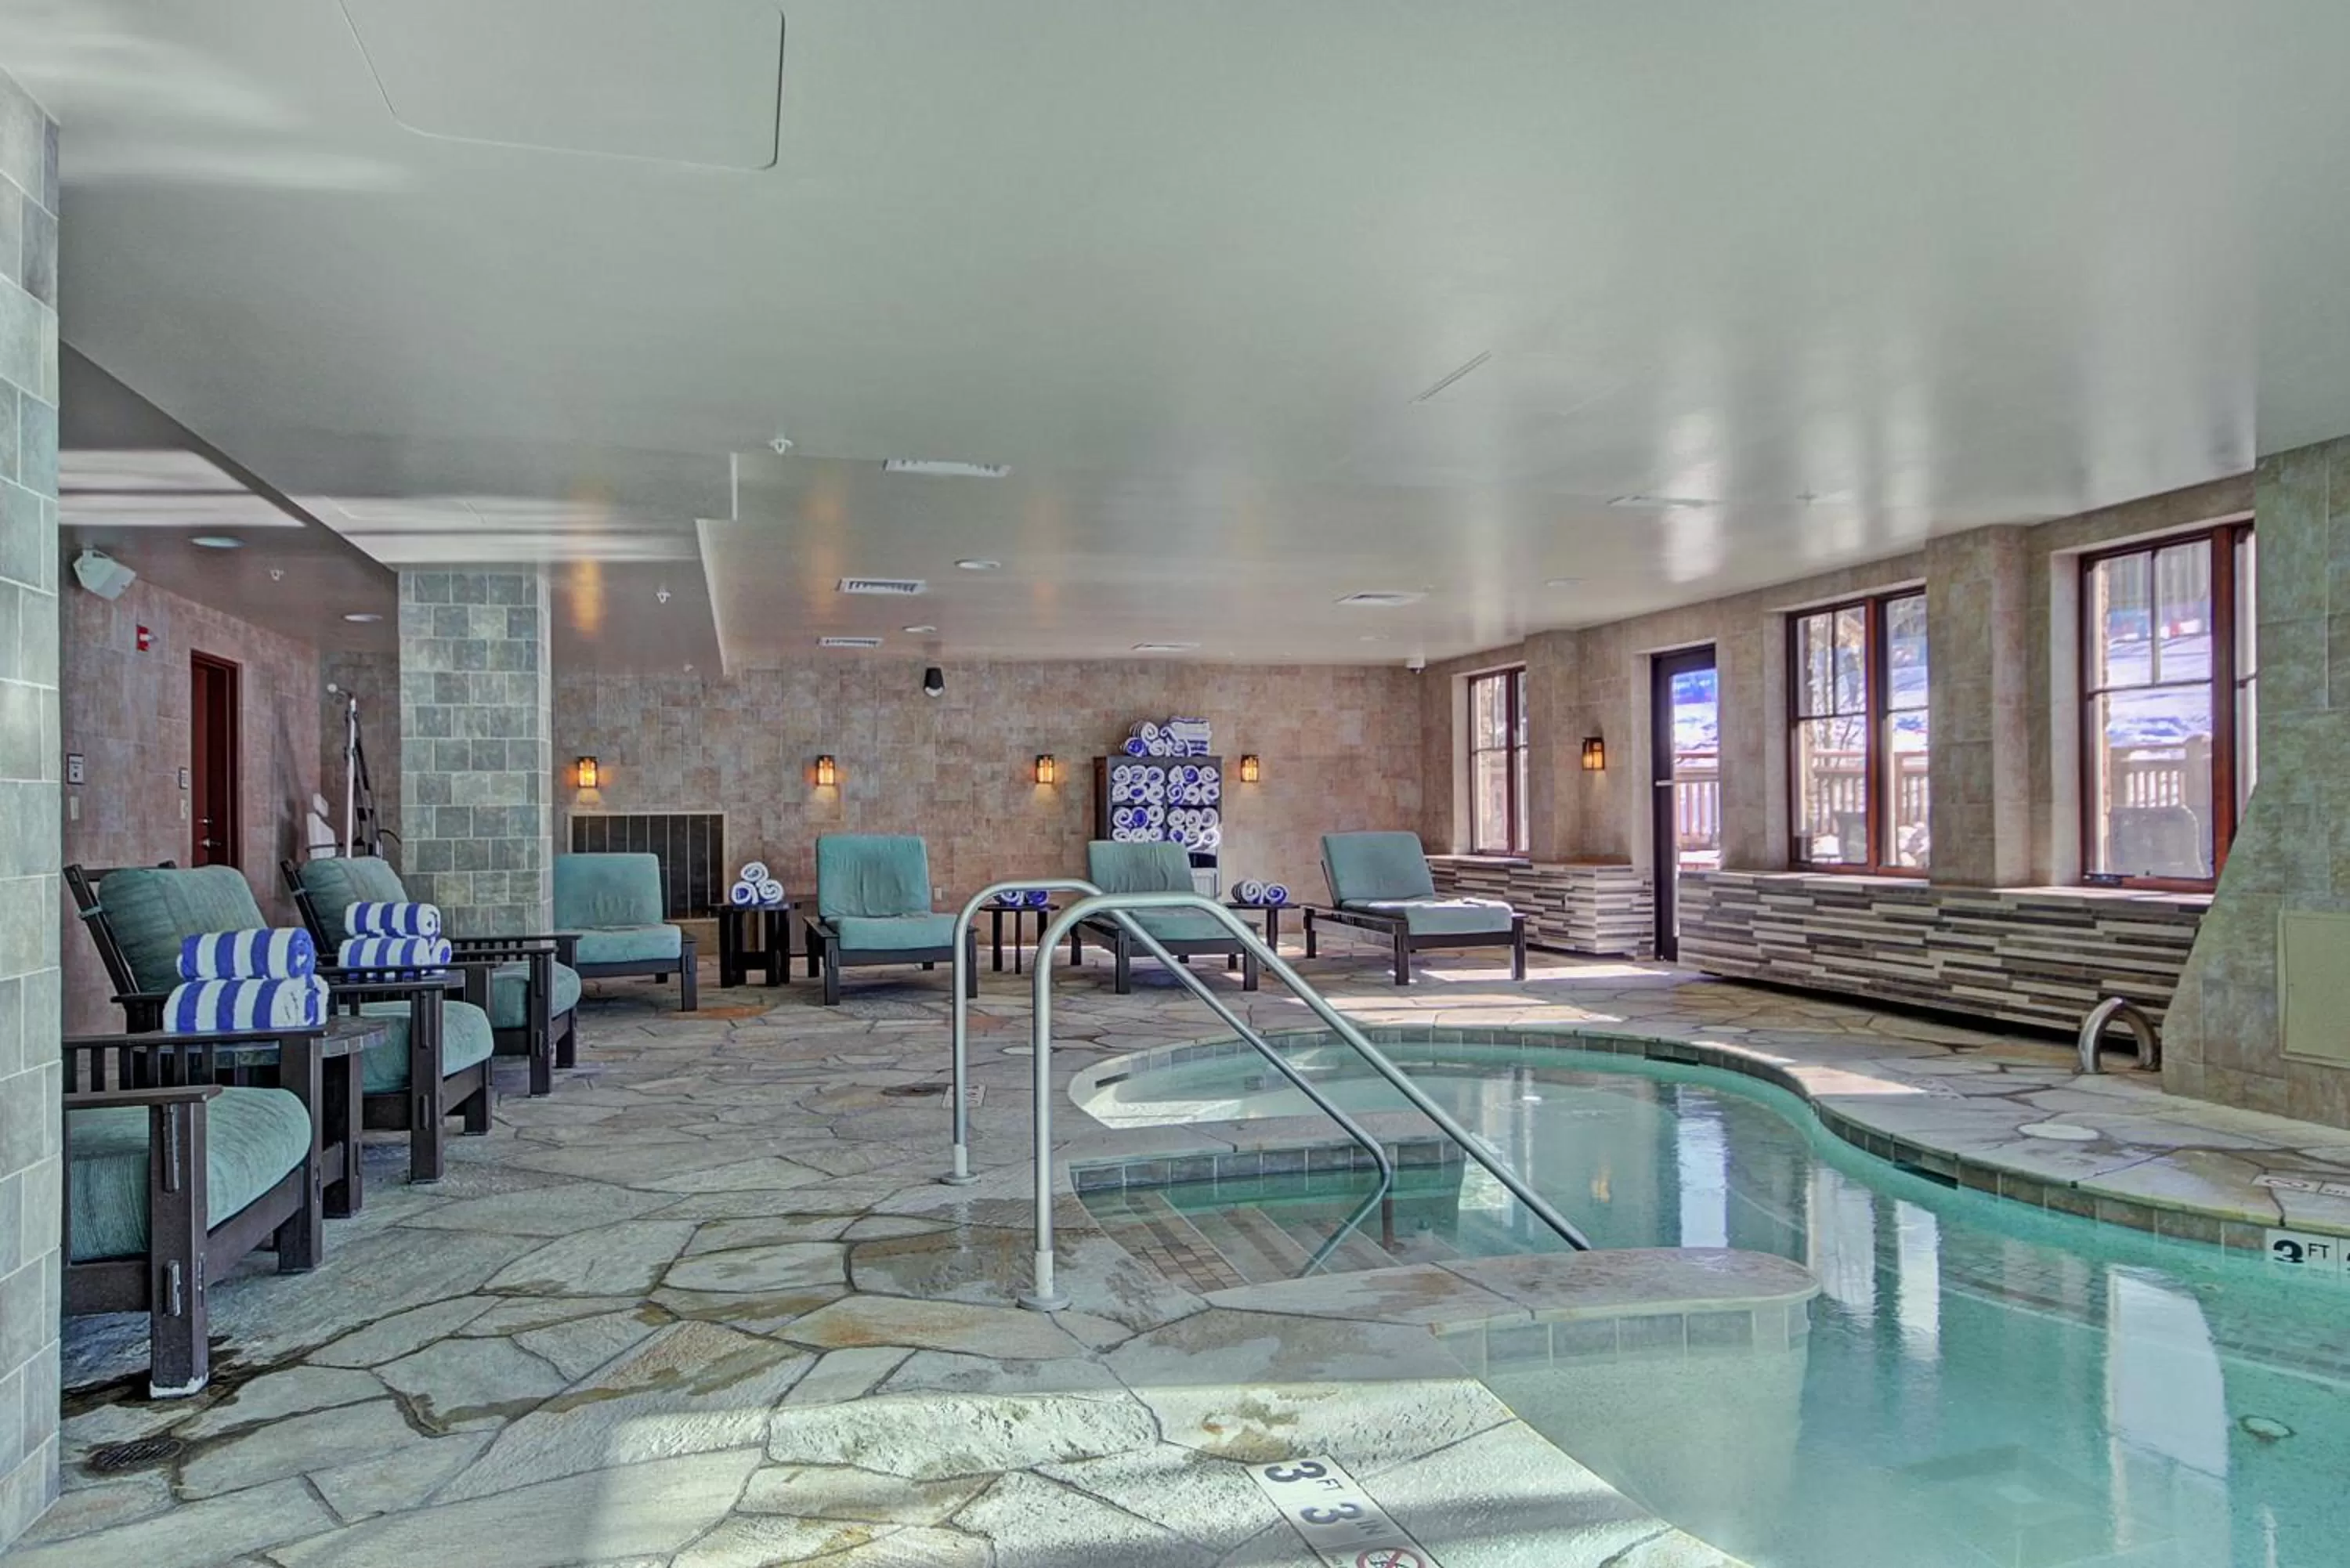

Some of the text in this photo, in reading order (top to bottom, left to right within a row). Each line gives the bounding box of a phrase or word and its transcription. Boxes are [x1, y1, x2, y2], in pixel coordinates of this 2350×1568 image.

[2308, 1242, 2330, 1259] FT
[1264, 1461, 1387, 1536] 3 FT 3 IN
